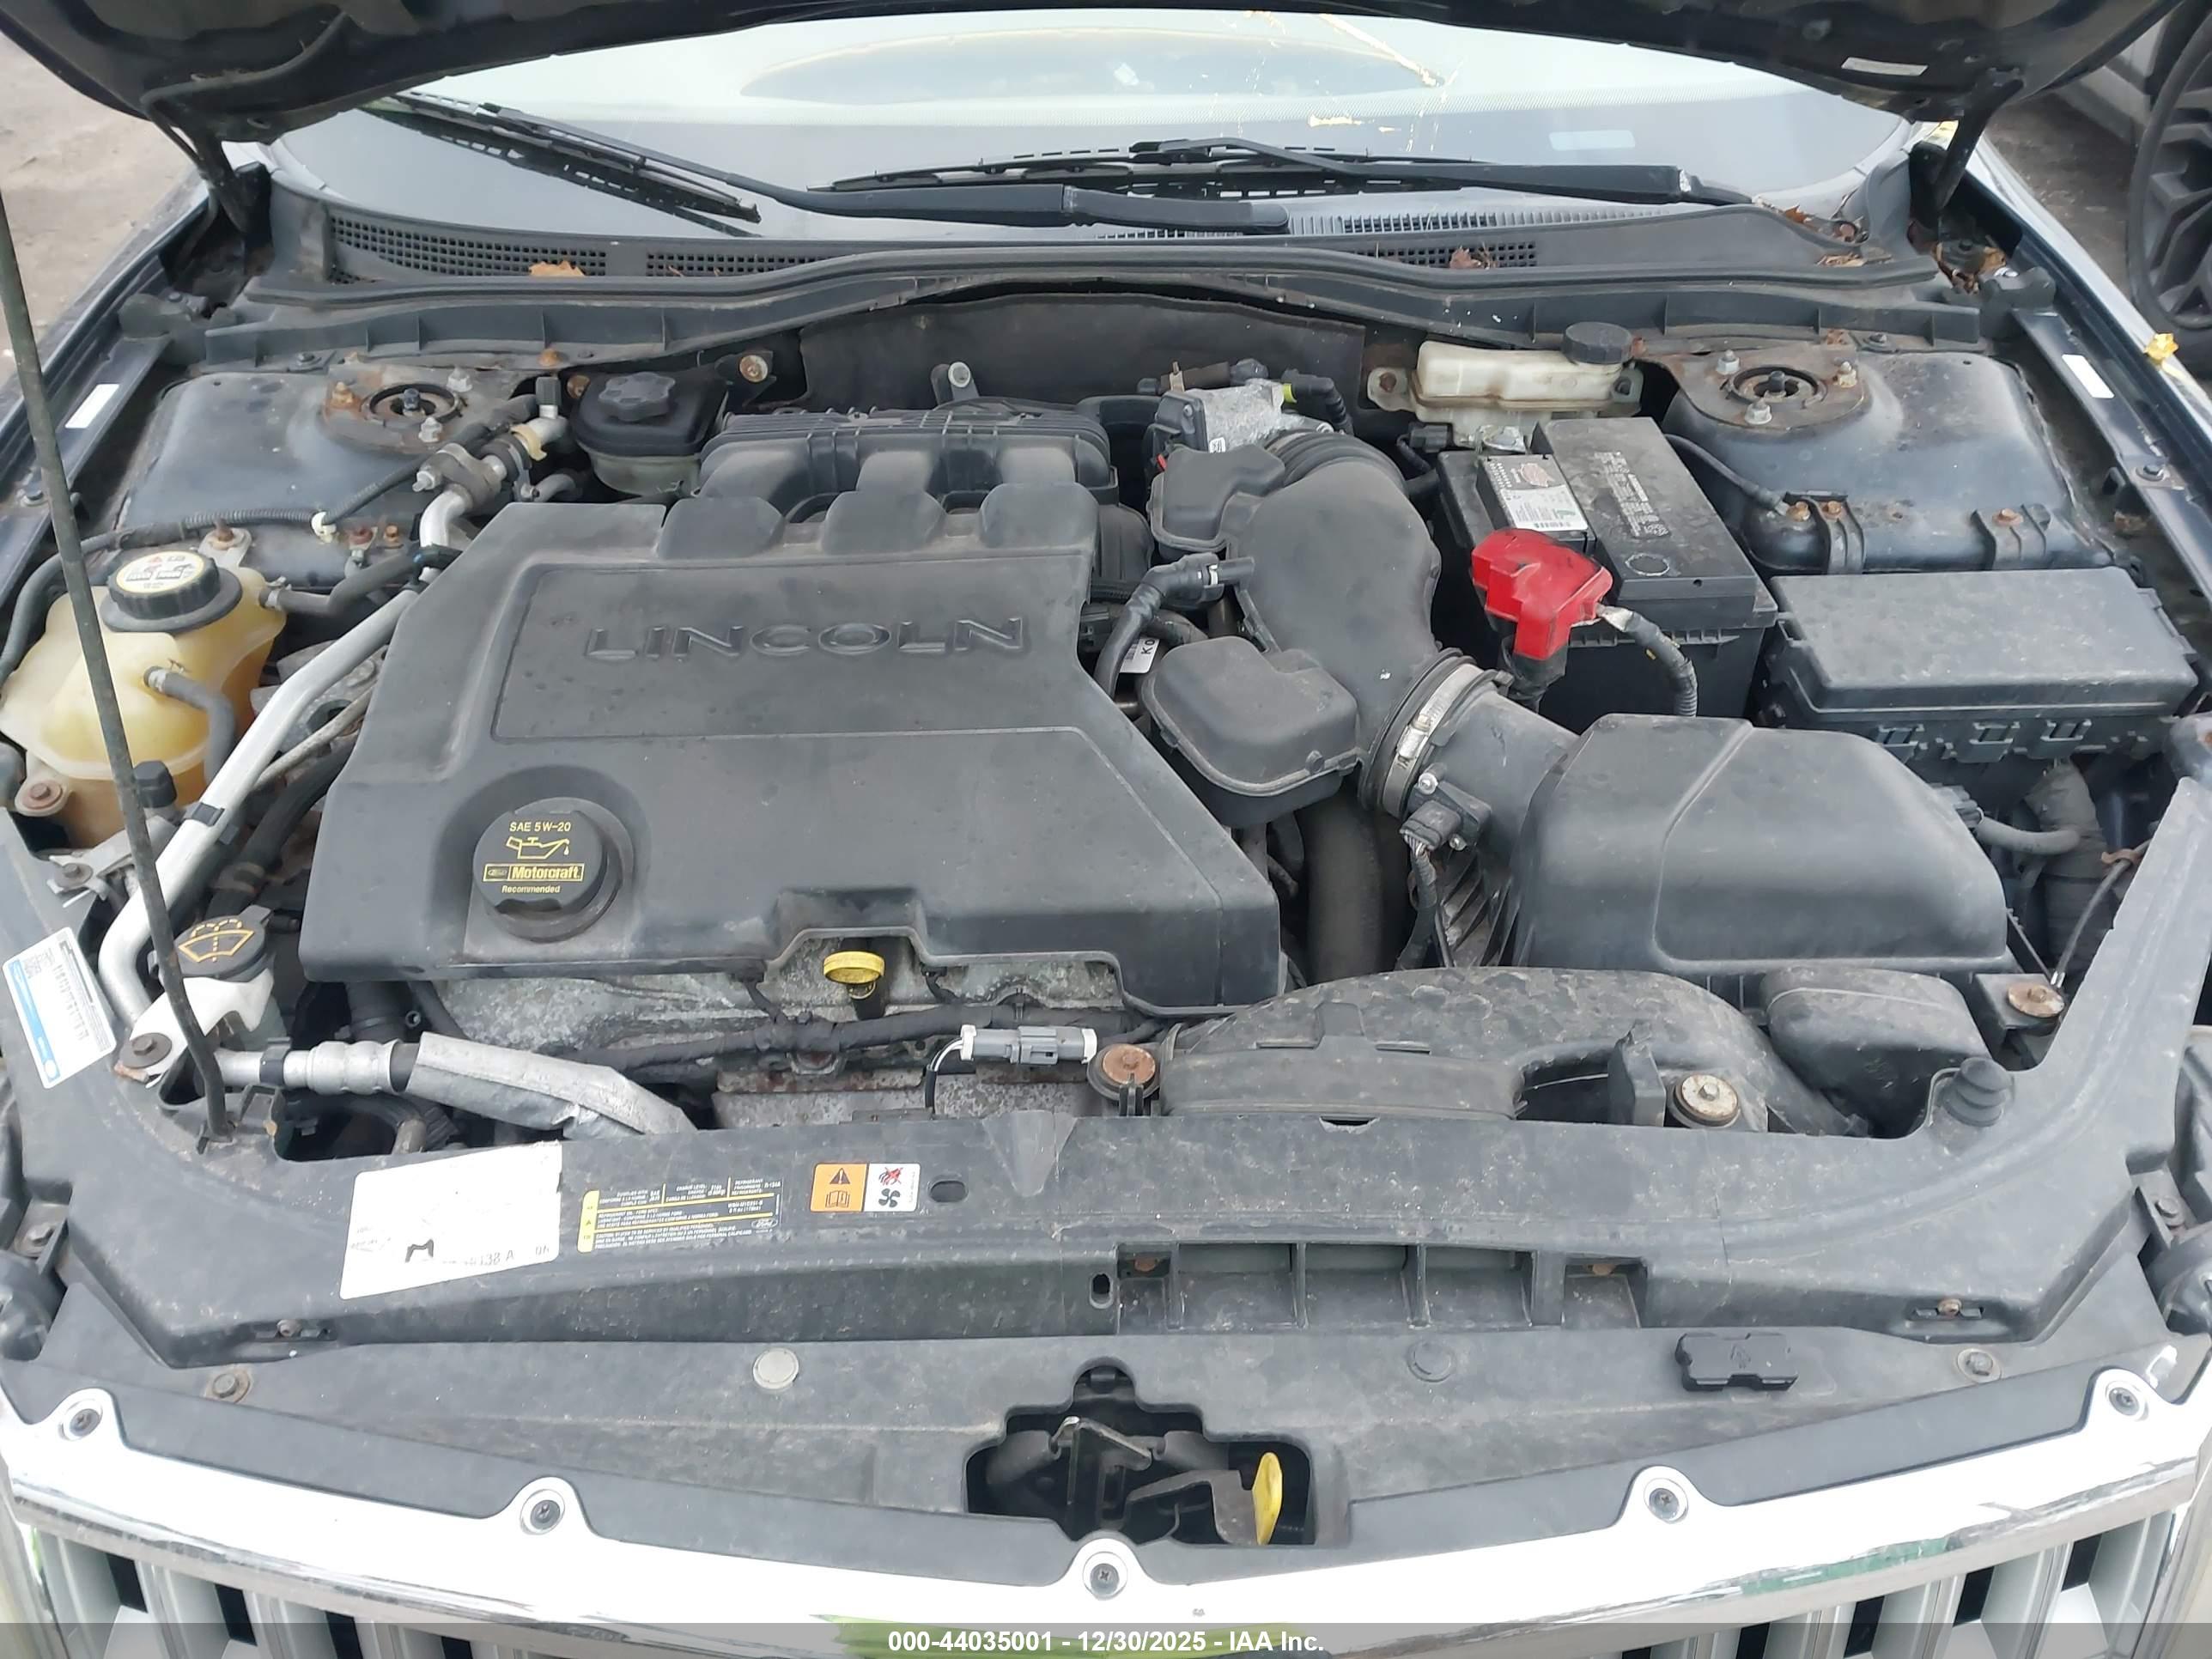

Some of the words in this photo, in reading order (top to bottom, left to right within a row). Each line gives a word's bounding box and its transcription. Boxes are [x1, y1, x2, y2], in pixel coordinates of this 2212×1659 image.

[585, 617, 1024, 660] LINCOLN
[509, 822, 532, 832] SAE
[534, 822, 572, 832] 5W-20
[513, 866, 579, 879] Motorcraft
[501, 884, 561, 894] Recommended
